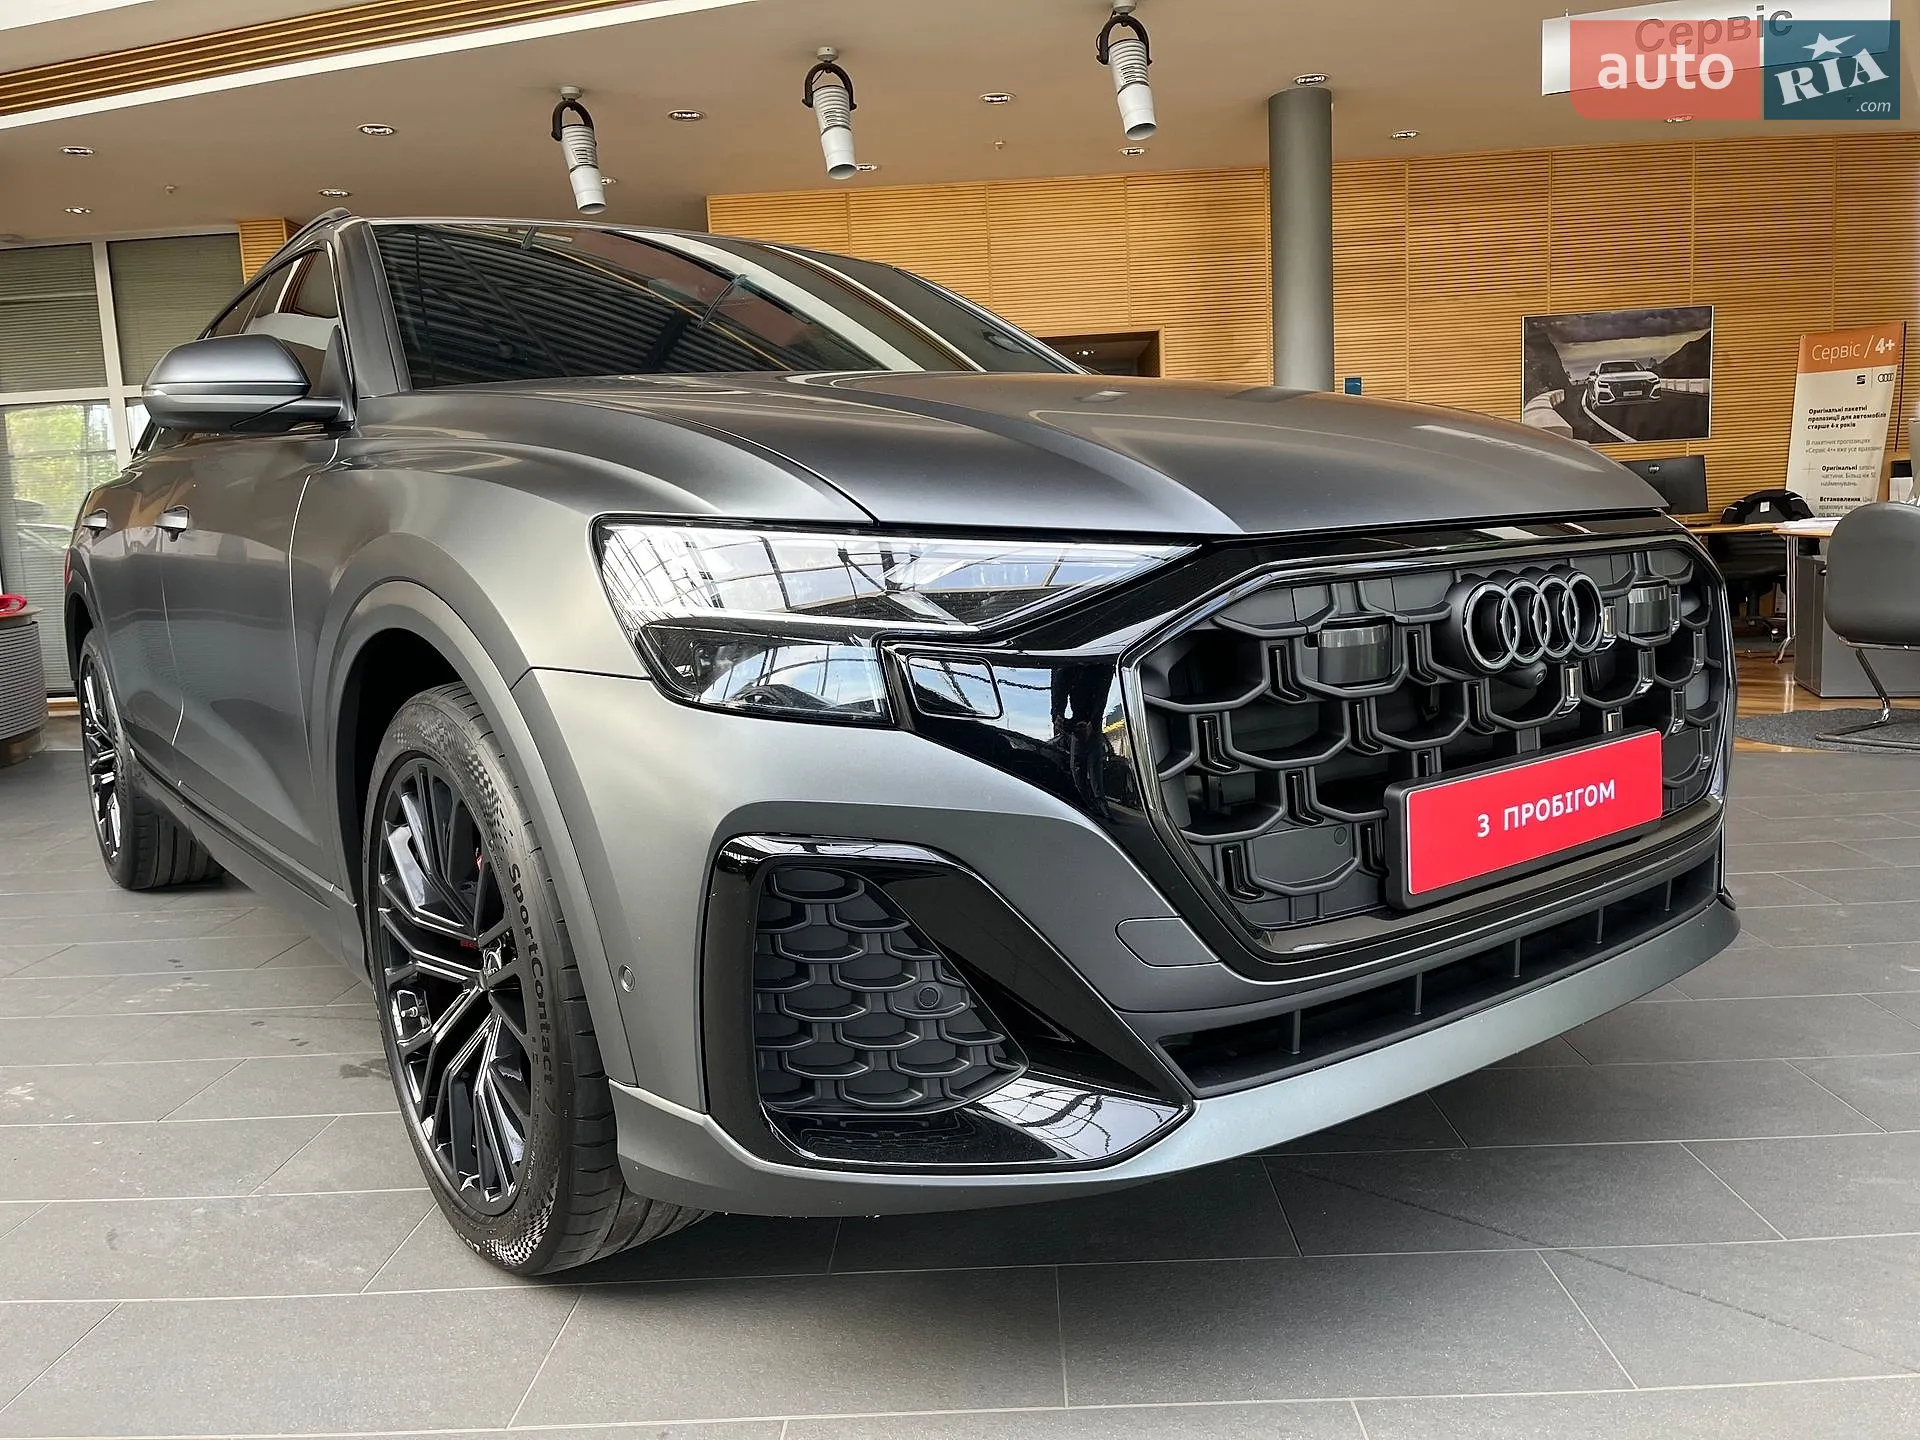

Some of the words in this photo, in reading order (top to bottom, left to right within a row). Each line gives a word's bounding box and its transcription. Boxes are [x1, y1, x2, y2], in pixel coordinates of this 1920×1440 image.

[1635, 4, 1793, 55] Сервіс
[1811, 341, 1861, 364] Сервіс
[1477, 813, 1491, 838] З
[1503, 779, 1616, 831] ПРОБІГОМ
[507, 862, 554, 1085] SportContact
